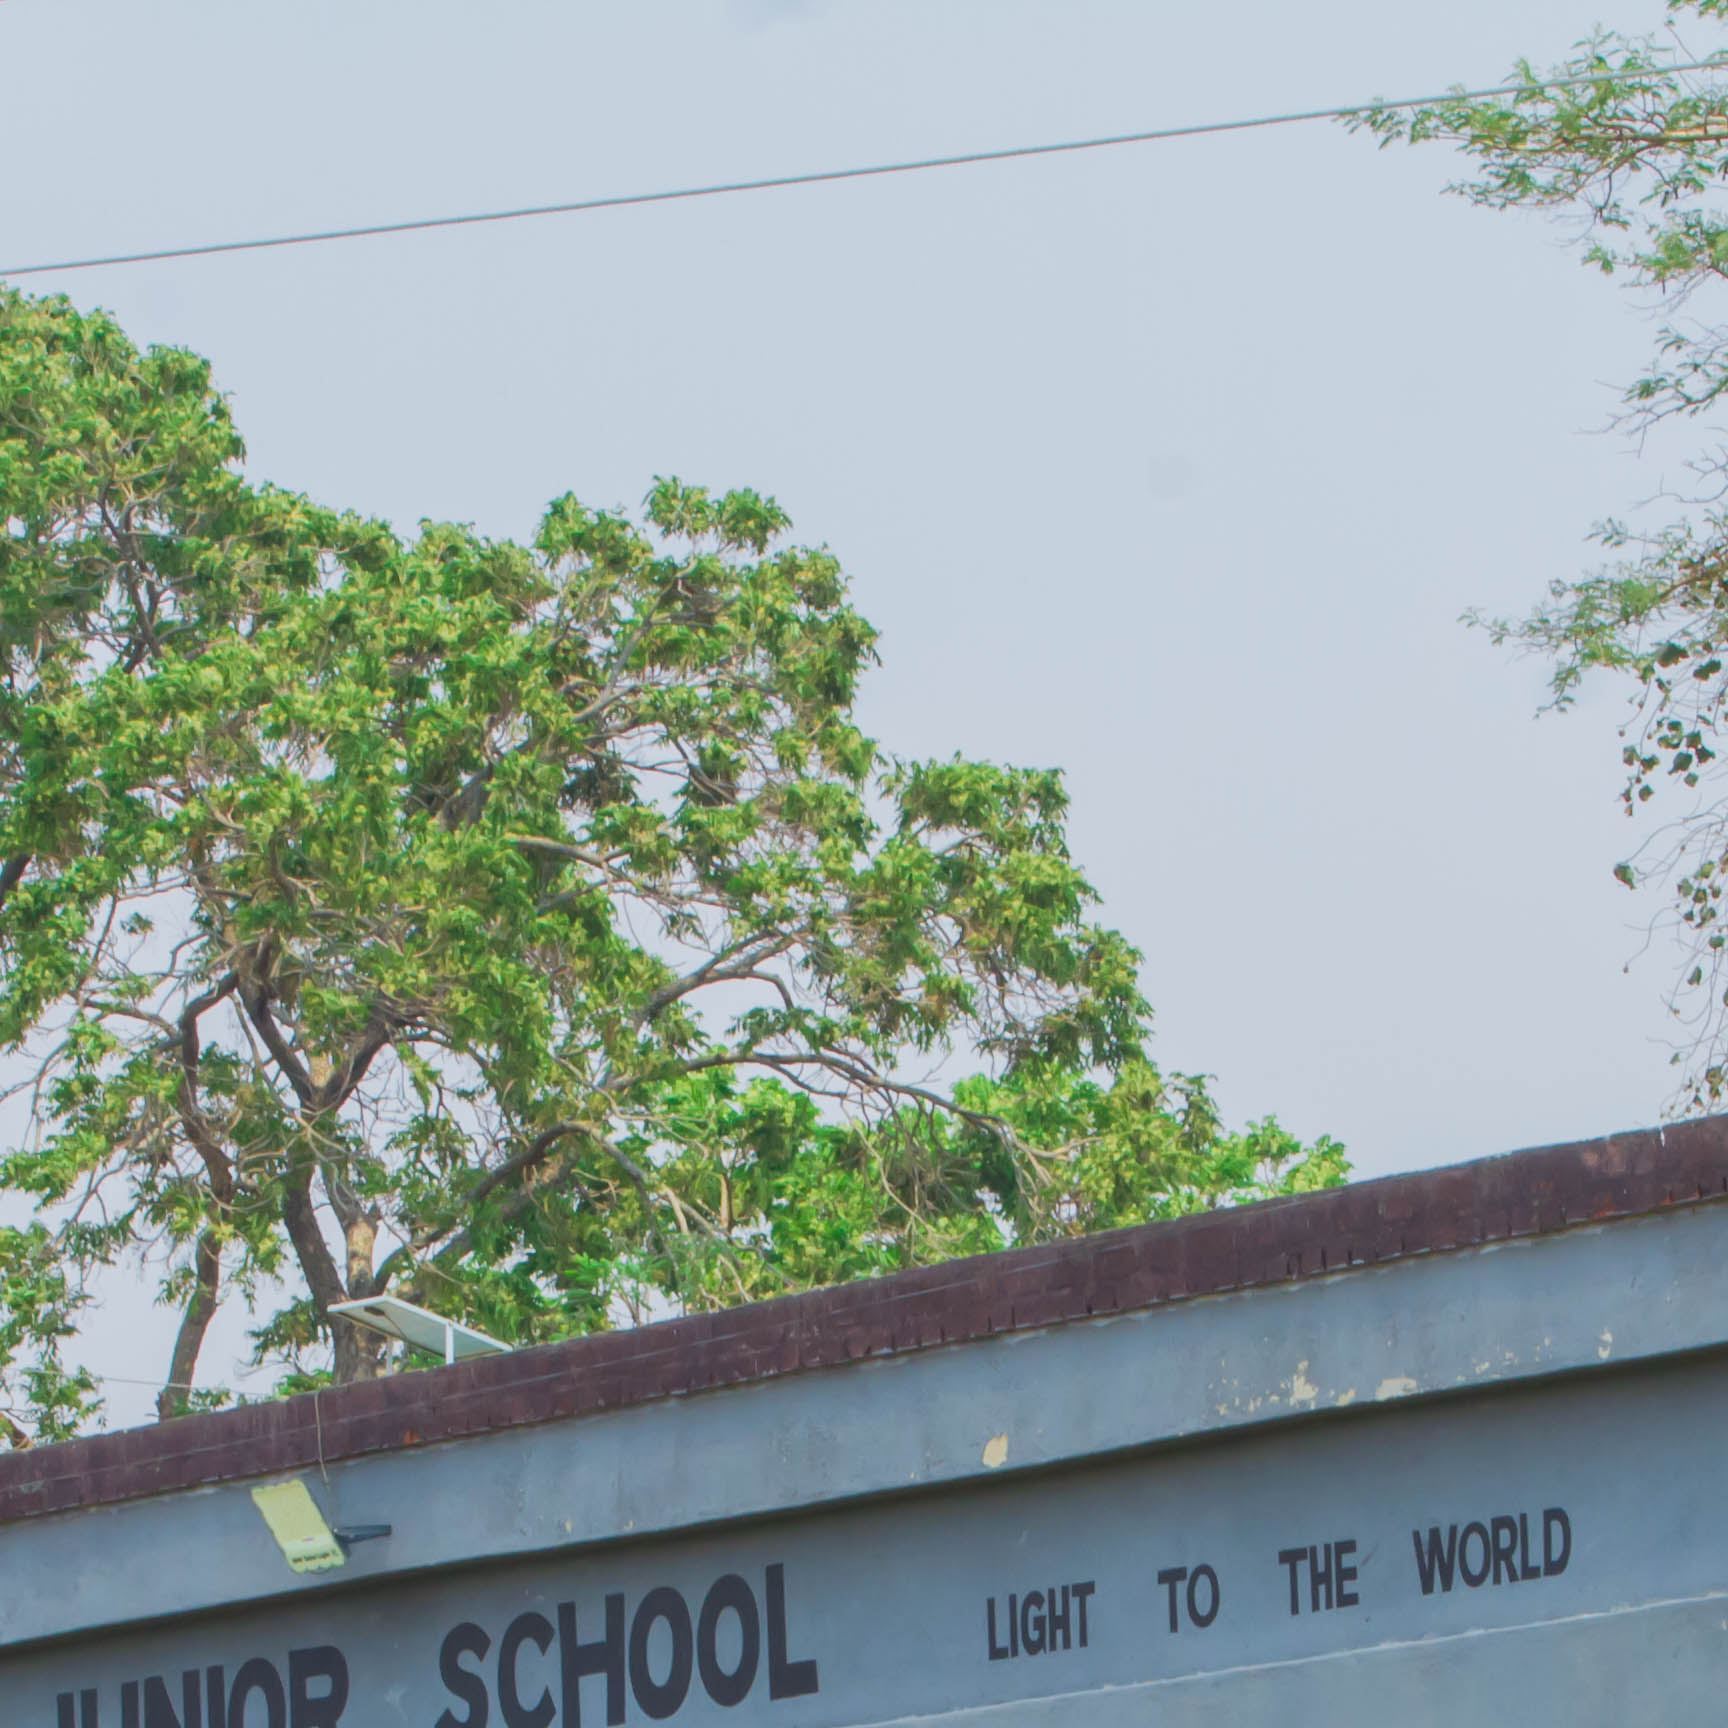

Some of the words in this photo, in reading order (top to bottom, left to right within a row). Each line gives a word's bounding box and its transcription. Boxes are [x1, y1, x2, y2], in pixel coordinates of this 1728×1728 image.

[986, 1580, 1096, 1662] LIGHT
[1157, 1563, 1221, 1634] TO
[1277, 1538, 1360, 1616] THE
[1412, 1506, 1572, 1596] WORLD
